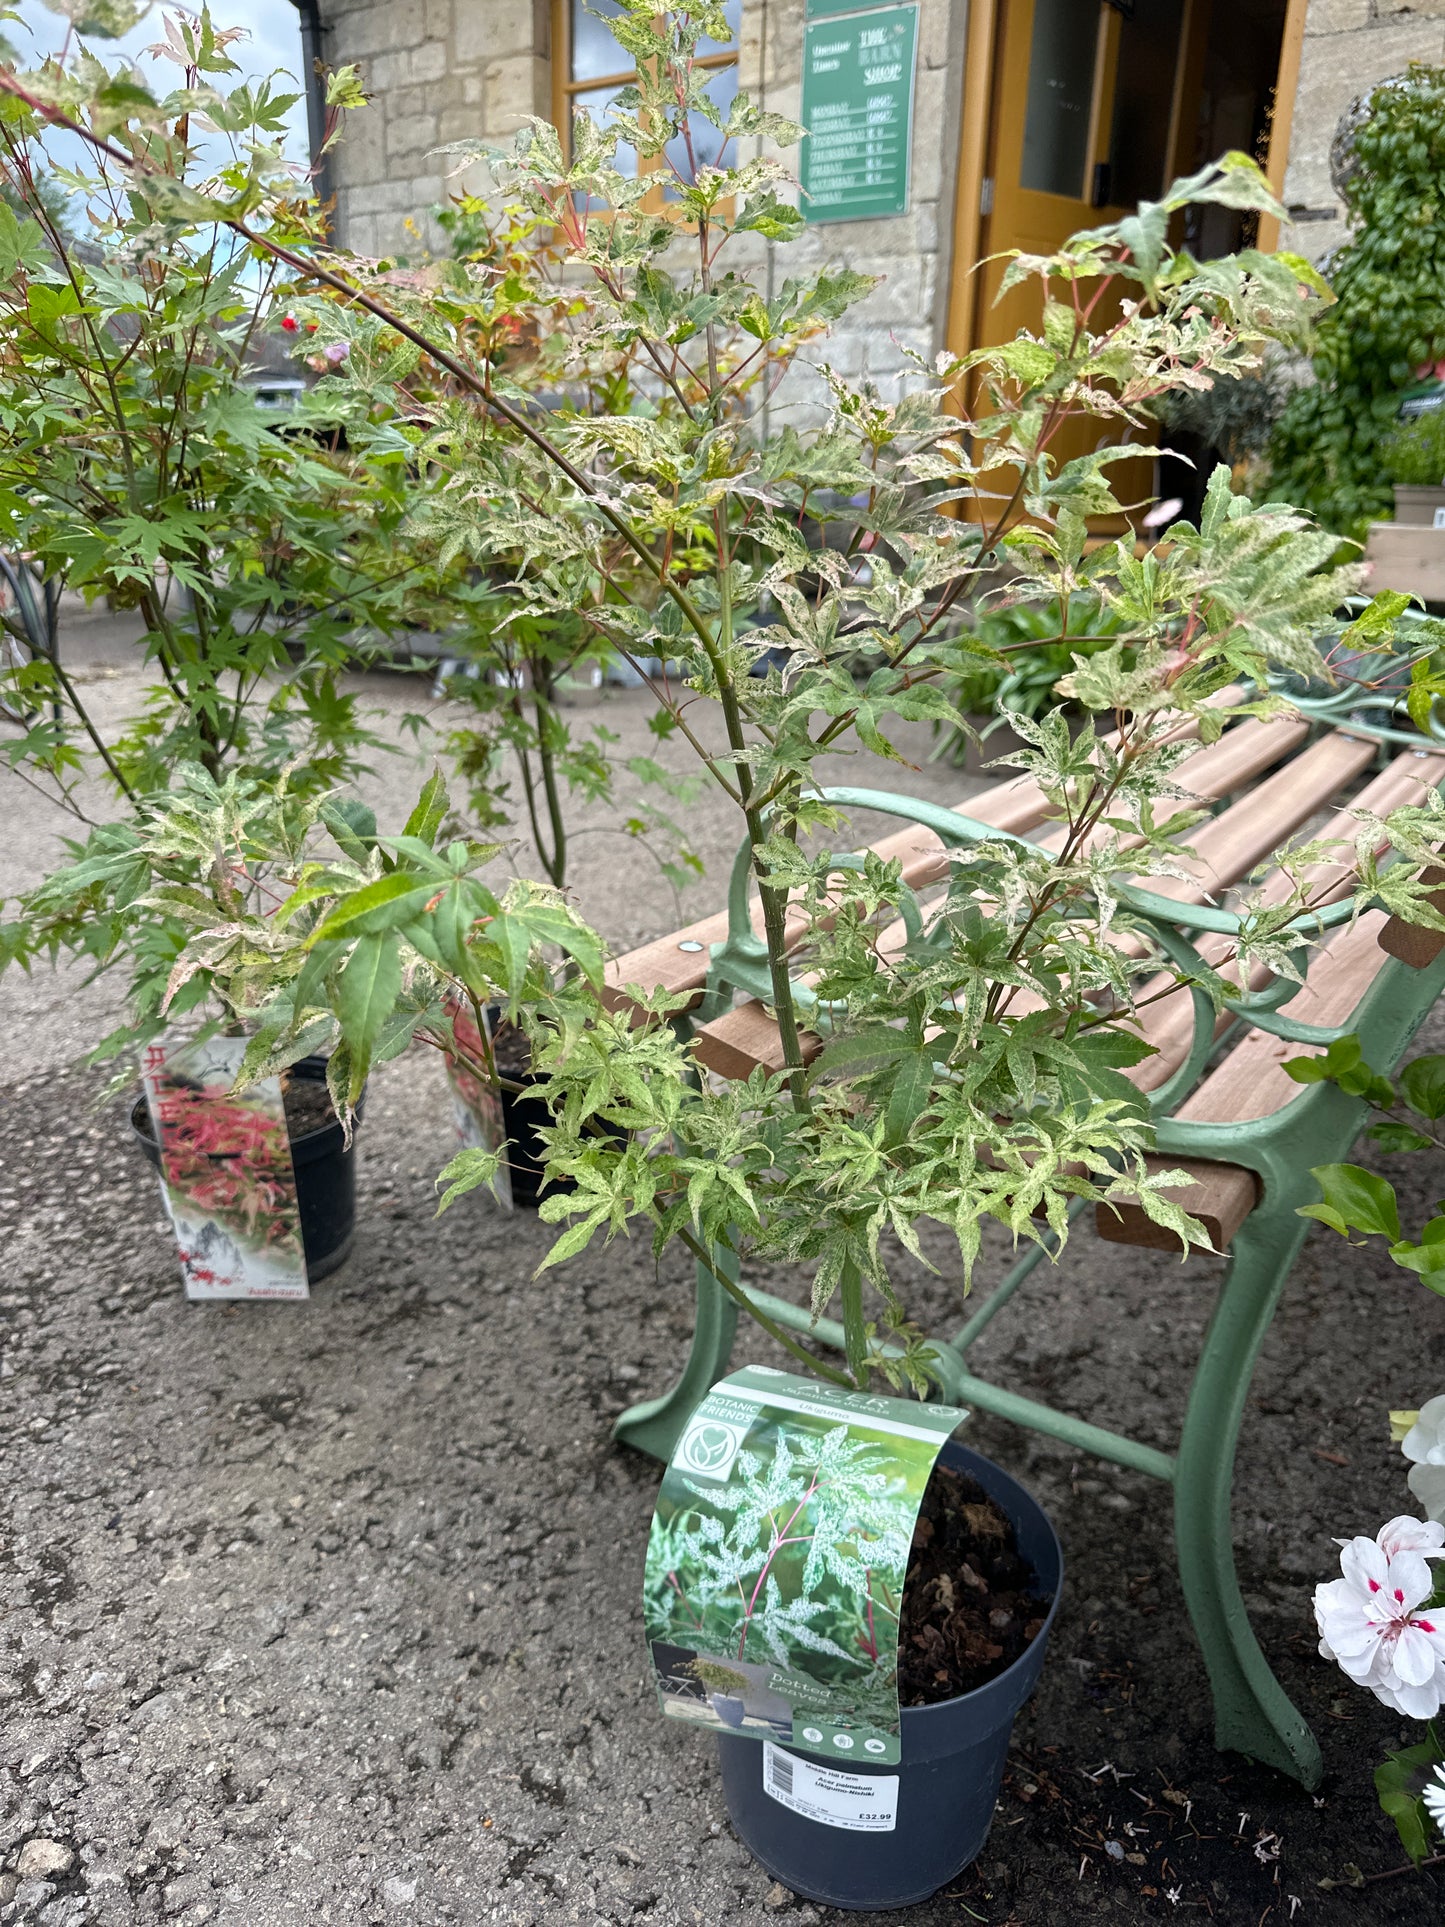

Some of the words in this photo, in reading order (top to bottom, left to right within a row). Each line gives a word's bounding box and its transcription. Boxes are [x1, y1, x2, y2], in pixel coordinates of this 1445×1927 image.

[859, 42, 902, 66] BARN
[864, 63, 902, 86] SHOP
[707, 1396, 759, 1413] BOTANIC
[798, 1384, 890, 1408] ACER
[701, 1404, 753, 1423] FRIENDS
[768, 1682, 827, 1705] Leaves
[772, 1673, 831, 1698] Dotted
[818, 1777, 835, 1785] Acer
[835, 1782, 873, 1791] palmatum
[828, 1770, 840, 1778] Hill
